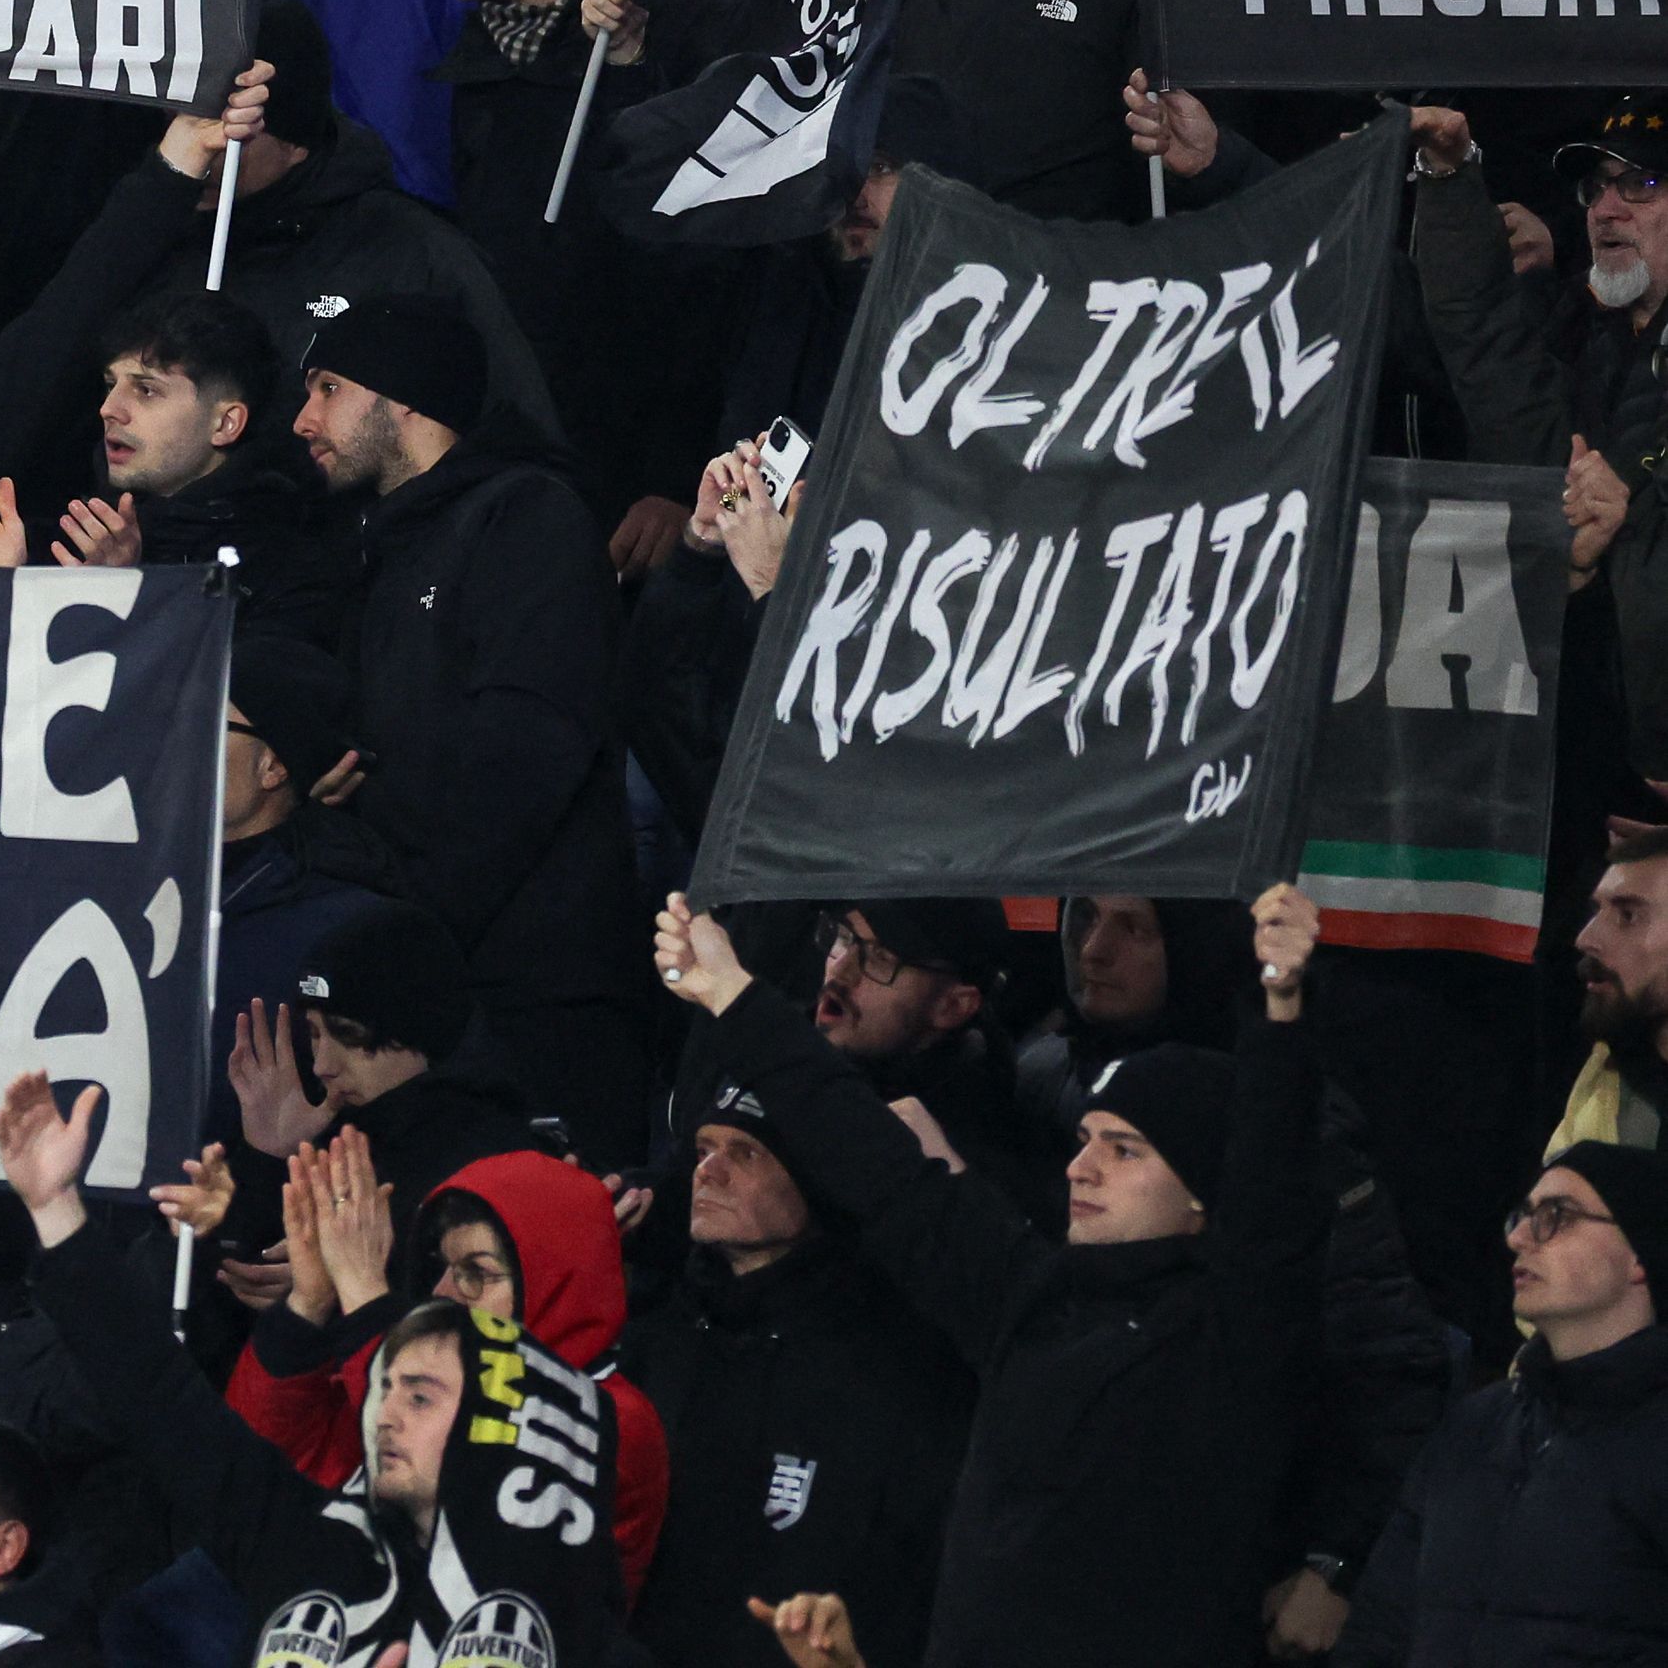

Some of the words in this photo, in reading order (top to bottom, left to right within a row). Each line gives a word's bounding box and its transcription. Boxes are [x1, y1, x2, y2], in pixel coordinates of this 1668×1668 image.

[320, 295, 337, 303] THE
[306, 302, 335, 311] NORTH
[313, 310, 335, 318] FACE
[776, 489, 1309, 763] RISULTATO
